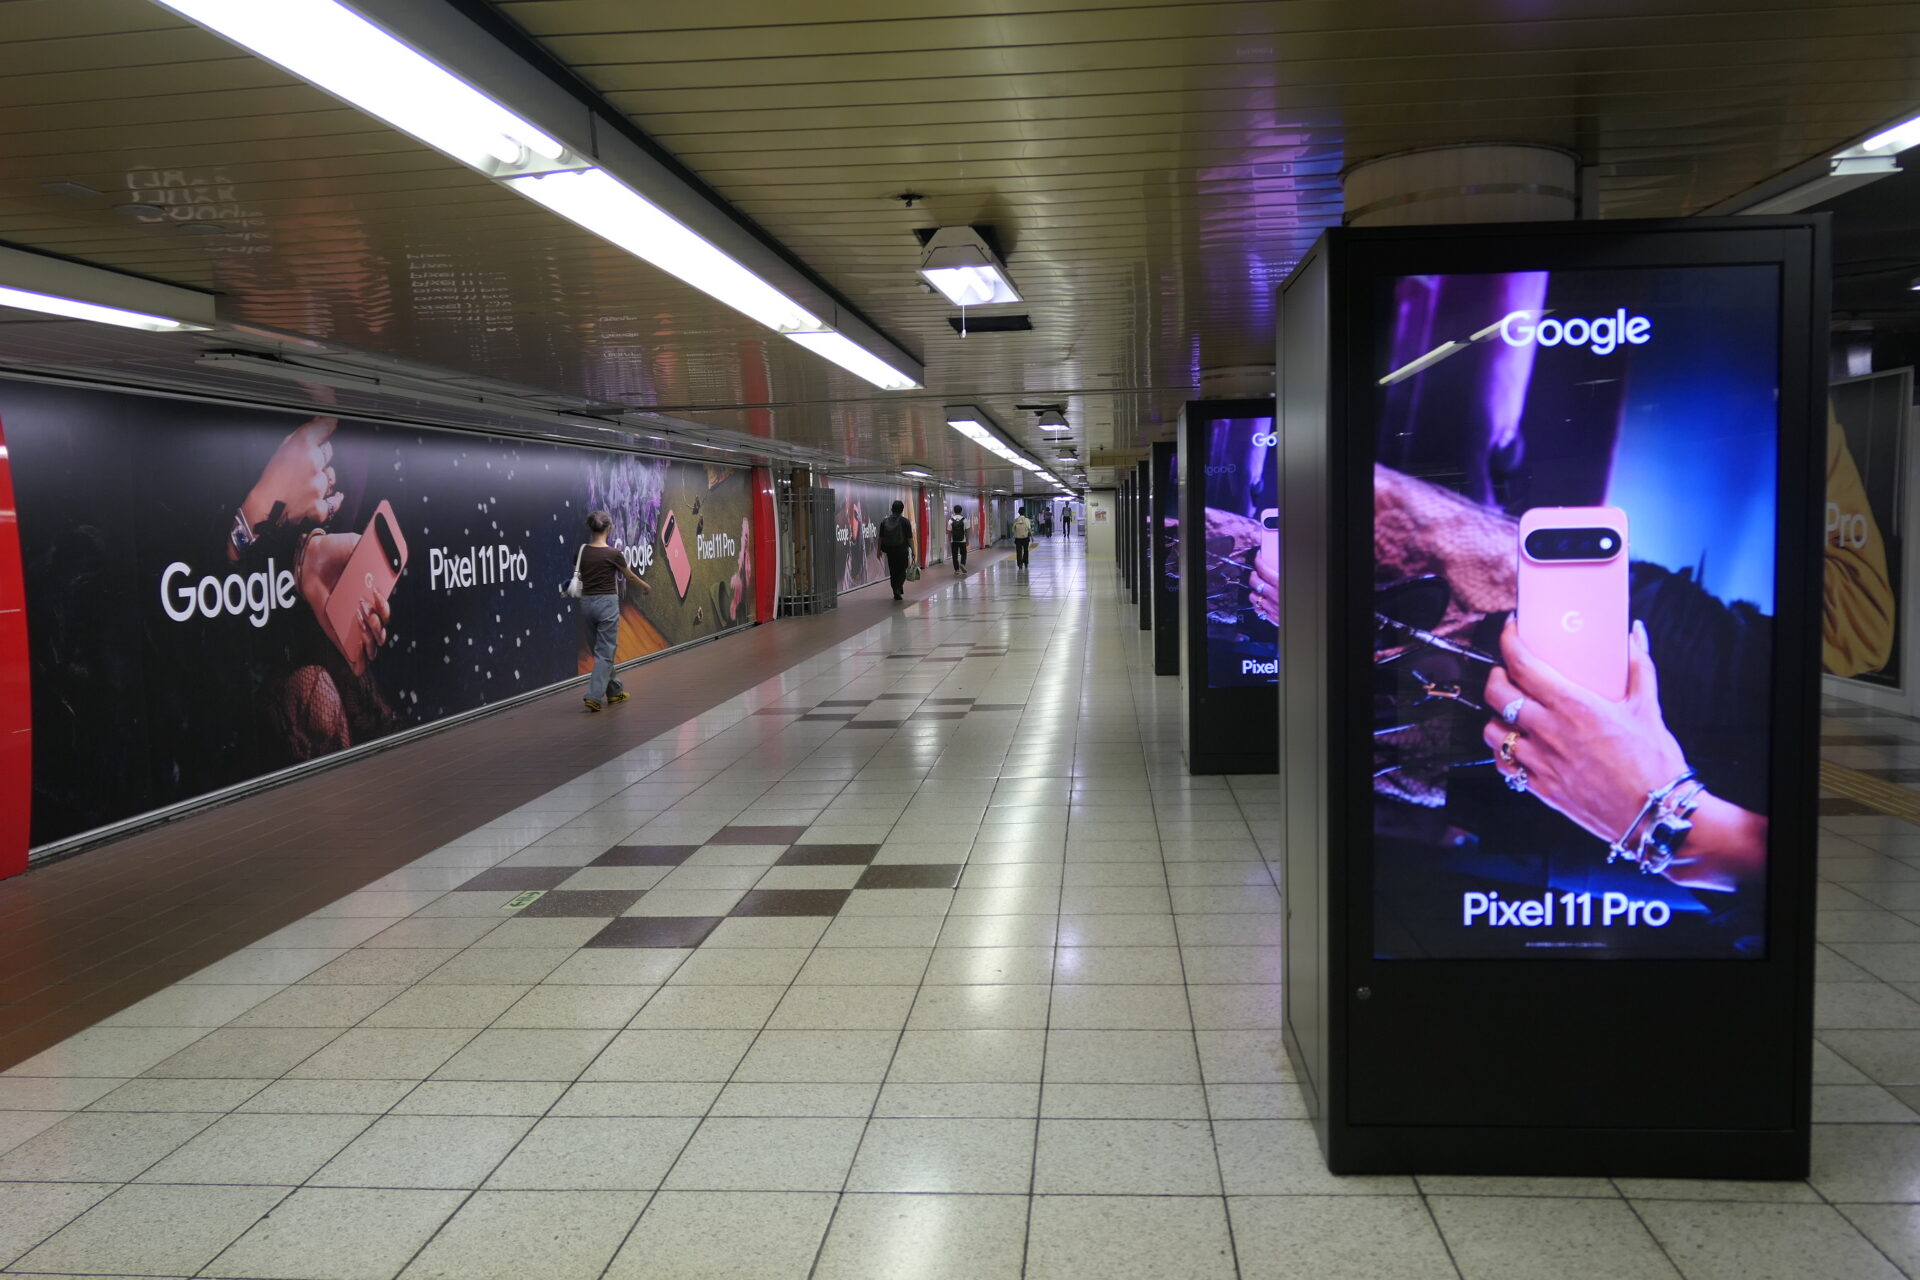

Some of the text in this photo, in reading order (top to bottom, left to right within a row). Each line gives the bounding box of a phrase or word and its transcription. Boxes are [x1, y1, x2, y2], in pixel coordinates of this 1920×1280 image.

[1500, 308, 1651, 355] Google
[697, 532, 736, 560] Pixel 11 Pro
[1825, 502, 1868, 549] Pro
[429, 544, 528, 590] Pixel 11 Pro
[161, 557, 297, 628] Google
[1560, 610, 1585, 633] G
[1242, 659, 1279, 675] Pixel
[1463, 891, 1671, 927] Pixel 11 Pro
